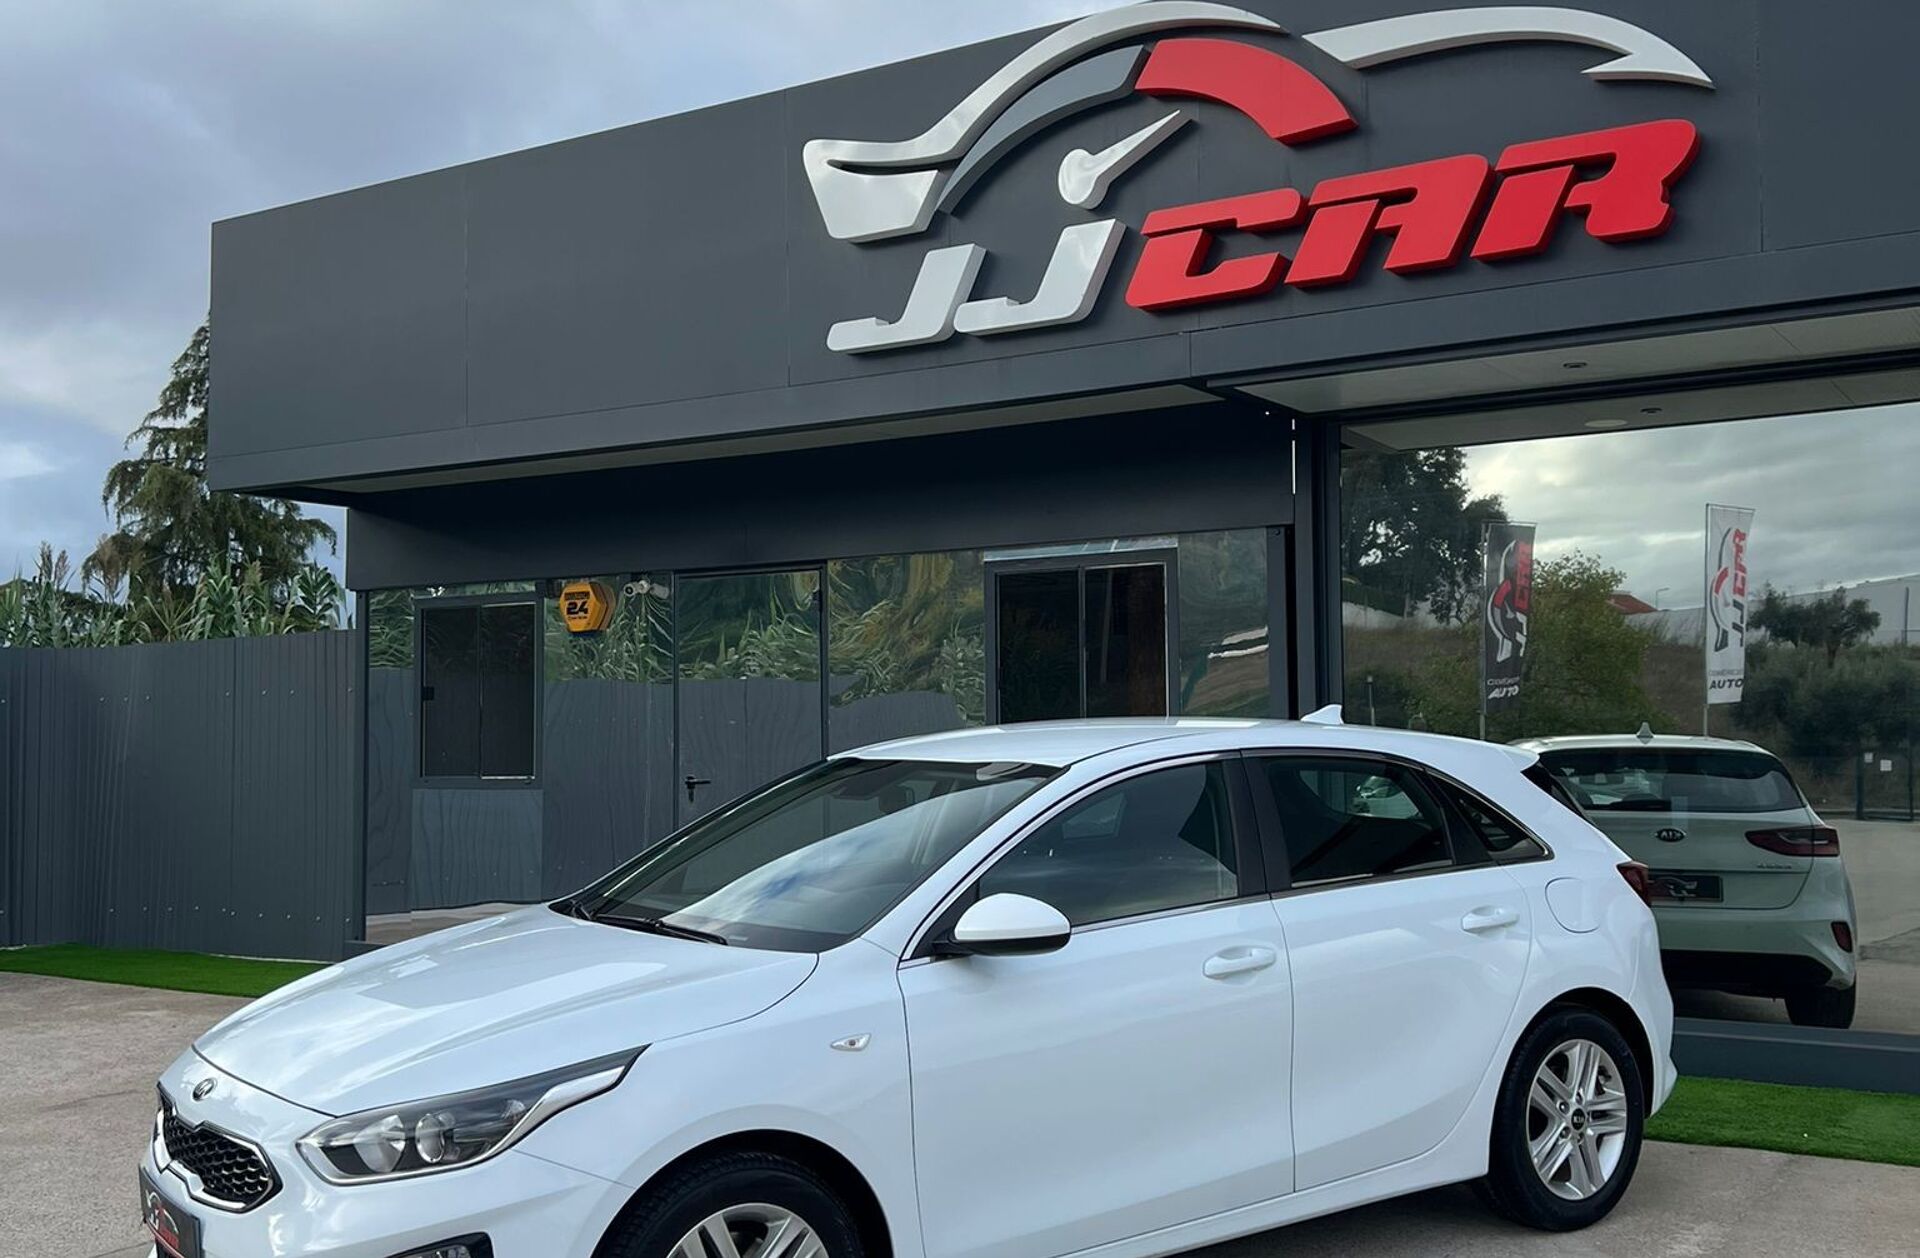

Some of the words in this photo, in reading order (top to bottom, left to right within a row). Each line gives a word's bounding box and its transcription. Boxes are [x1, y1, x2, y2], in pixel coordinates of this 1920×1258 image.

[566, 601, 588, 616] 24
[1487, 684, 1520, 699] AUTO
[1709, 678, 1745, 690] AUTO
